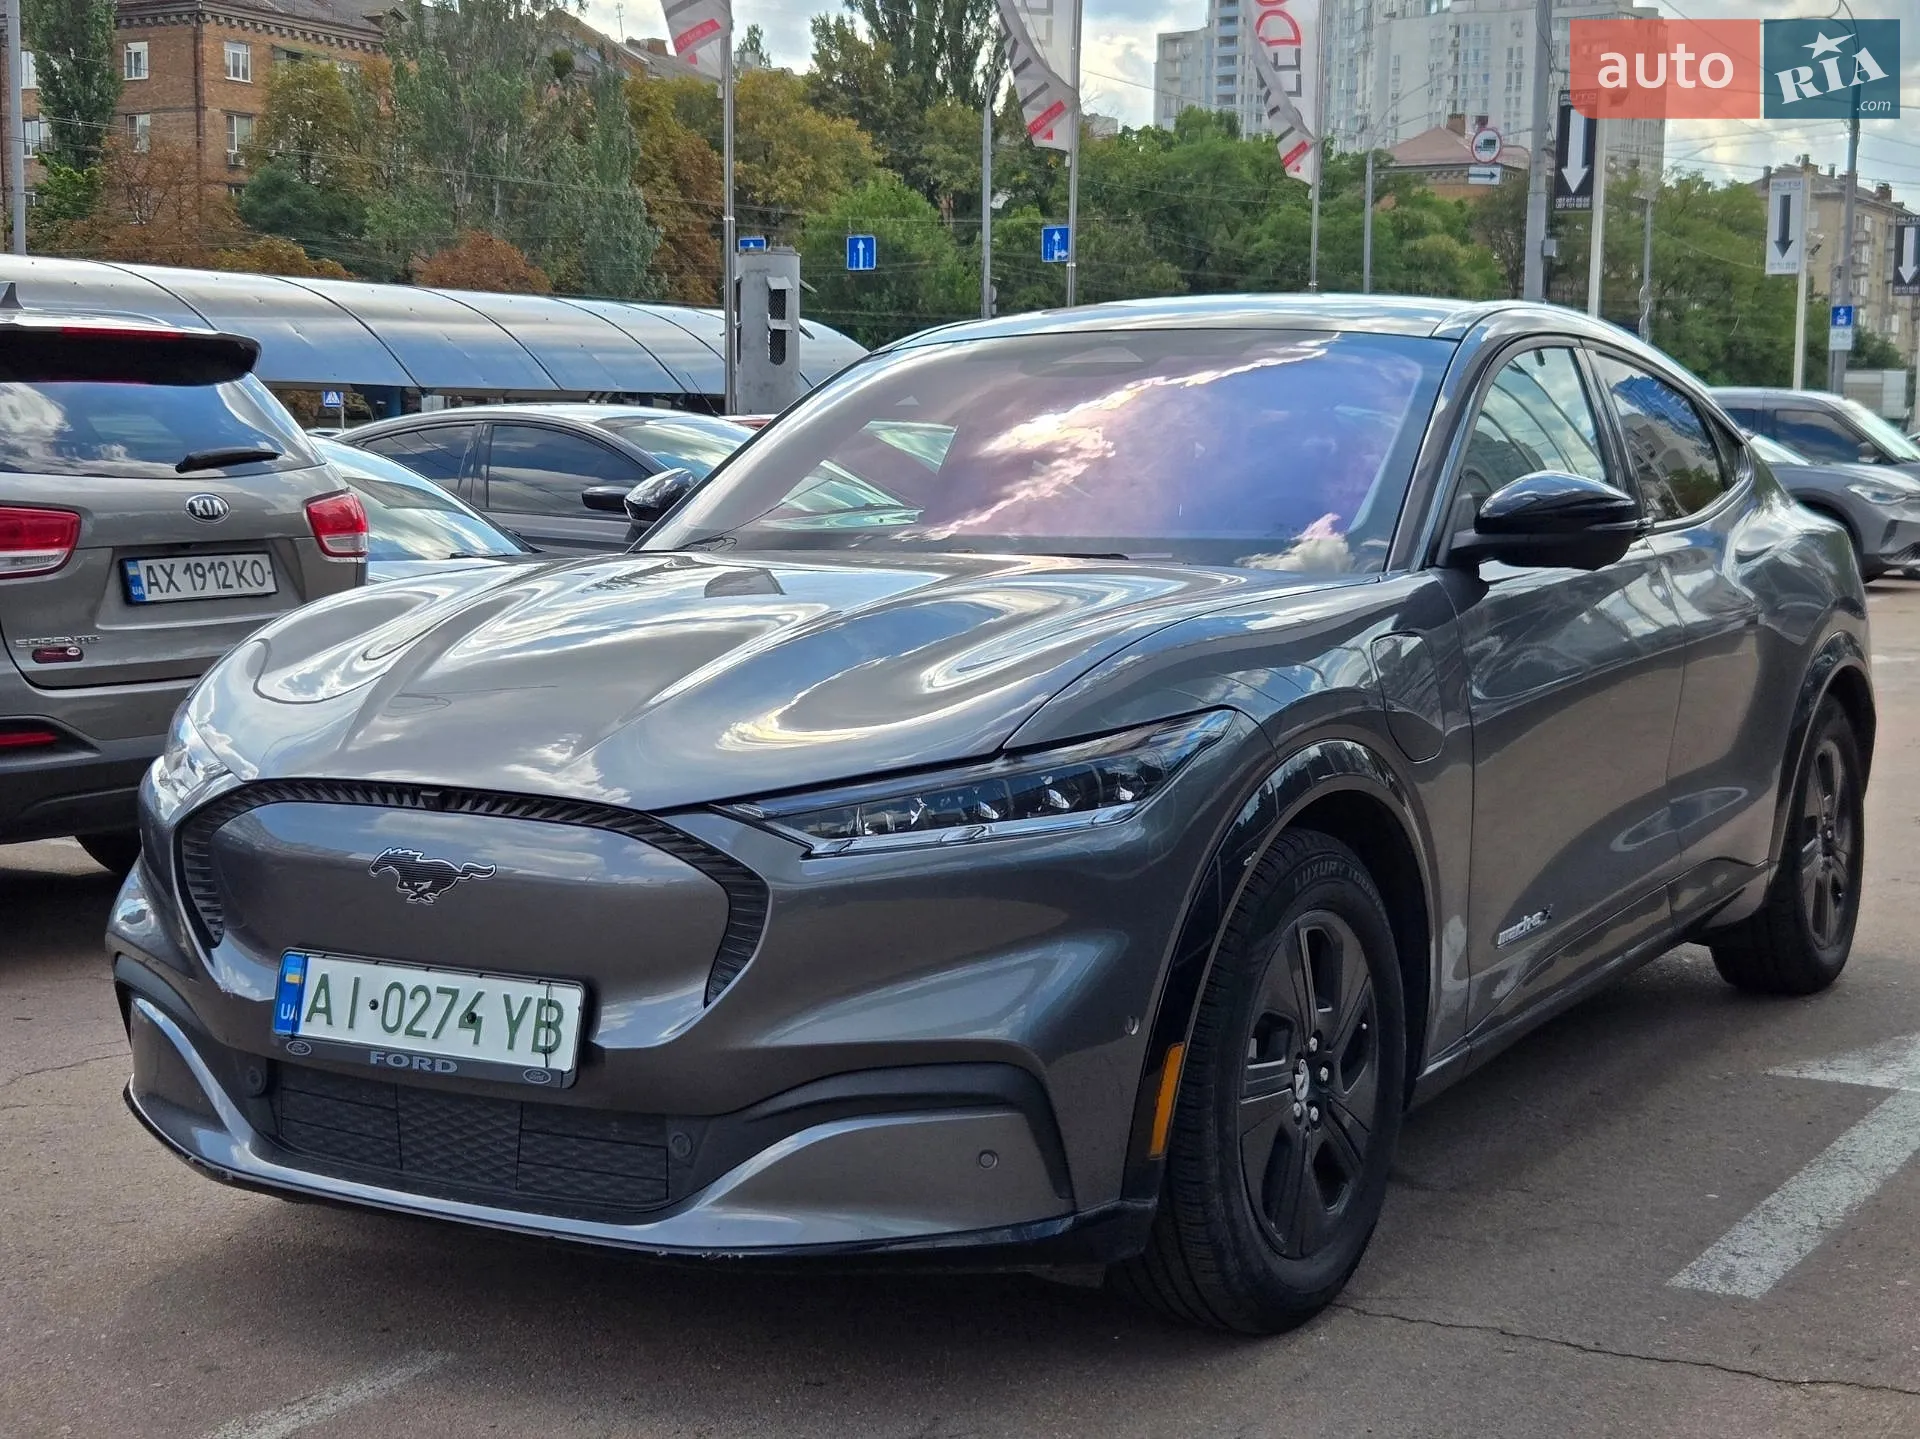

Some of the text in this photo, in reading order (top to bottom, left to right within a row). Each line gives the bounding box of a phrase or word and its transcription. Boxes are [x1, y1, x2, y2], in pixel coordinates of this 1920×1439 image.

[191, 499, 225, 516] KIA
[145, 560, 266, 594] AX 1912 KO
[132, 586, 144, 595] UA
[280, 1002, 298, 1021] UA
[305, 972, 564, 1055] AI 0274 YB
[369, 1051, 458, 1073] FORD
